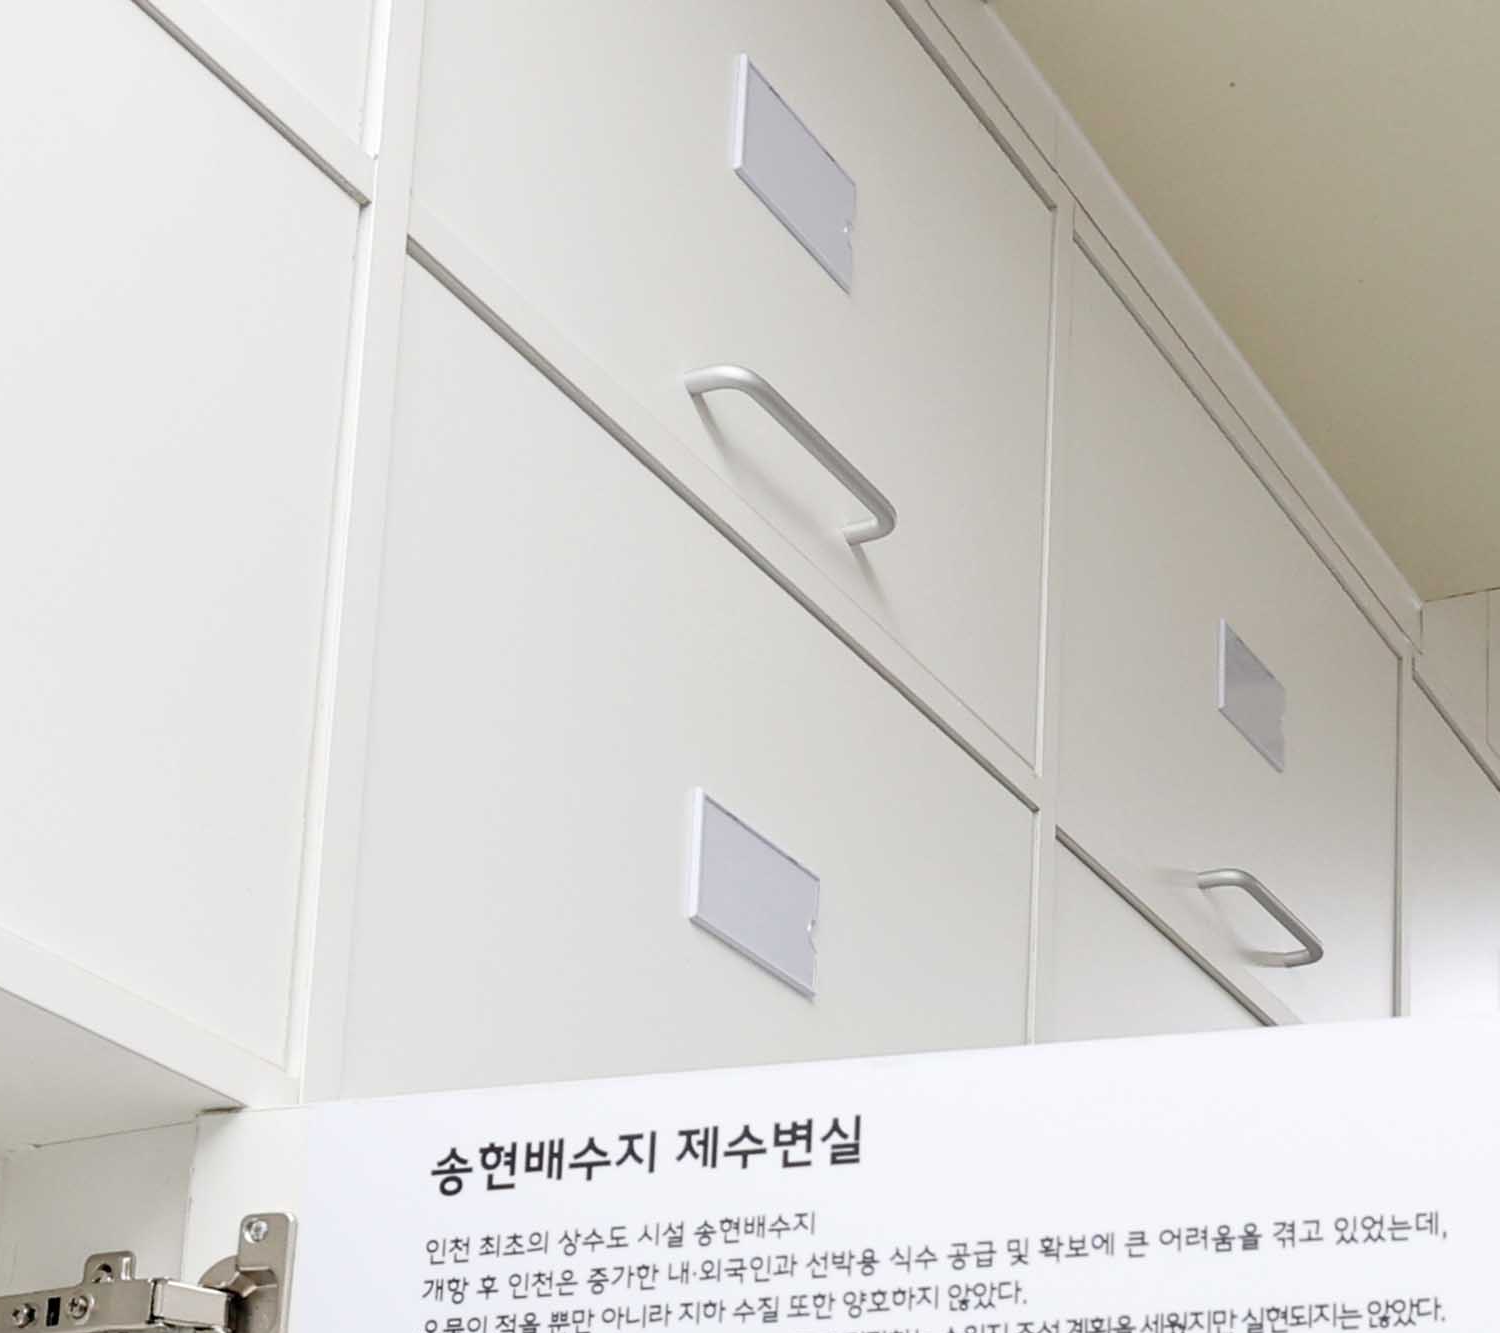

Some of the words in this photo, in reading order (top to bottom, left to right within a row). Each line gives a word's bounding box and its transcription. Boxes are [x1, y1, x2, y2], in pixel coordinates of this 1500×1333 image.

[430, 1130, 657, 1197] 송현배수지
[675, 1114, 862, 1170] 제수변실
[425, 1237, 471, 1266] 인천
[478, 1231, 549, 1258] 최초의
[557, 1225, 629, 1257] 상수도
[637, 1221, 684, 1249] 시설
[693, 1212, 815, 1247] 송현배수지
[601, 1303, 673, 1330] 아니라
[678, 1299, 727, 1325] 지하
[732, 1296, 779, 1324] 수질
[787, 1292, 836, 1321] 또한
[843, 1286, 939, 1319] 양호하지
[947, 1280, 1027, 1312] 않았다.
